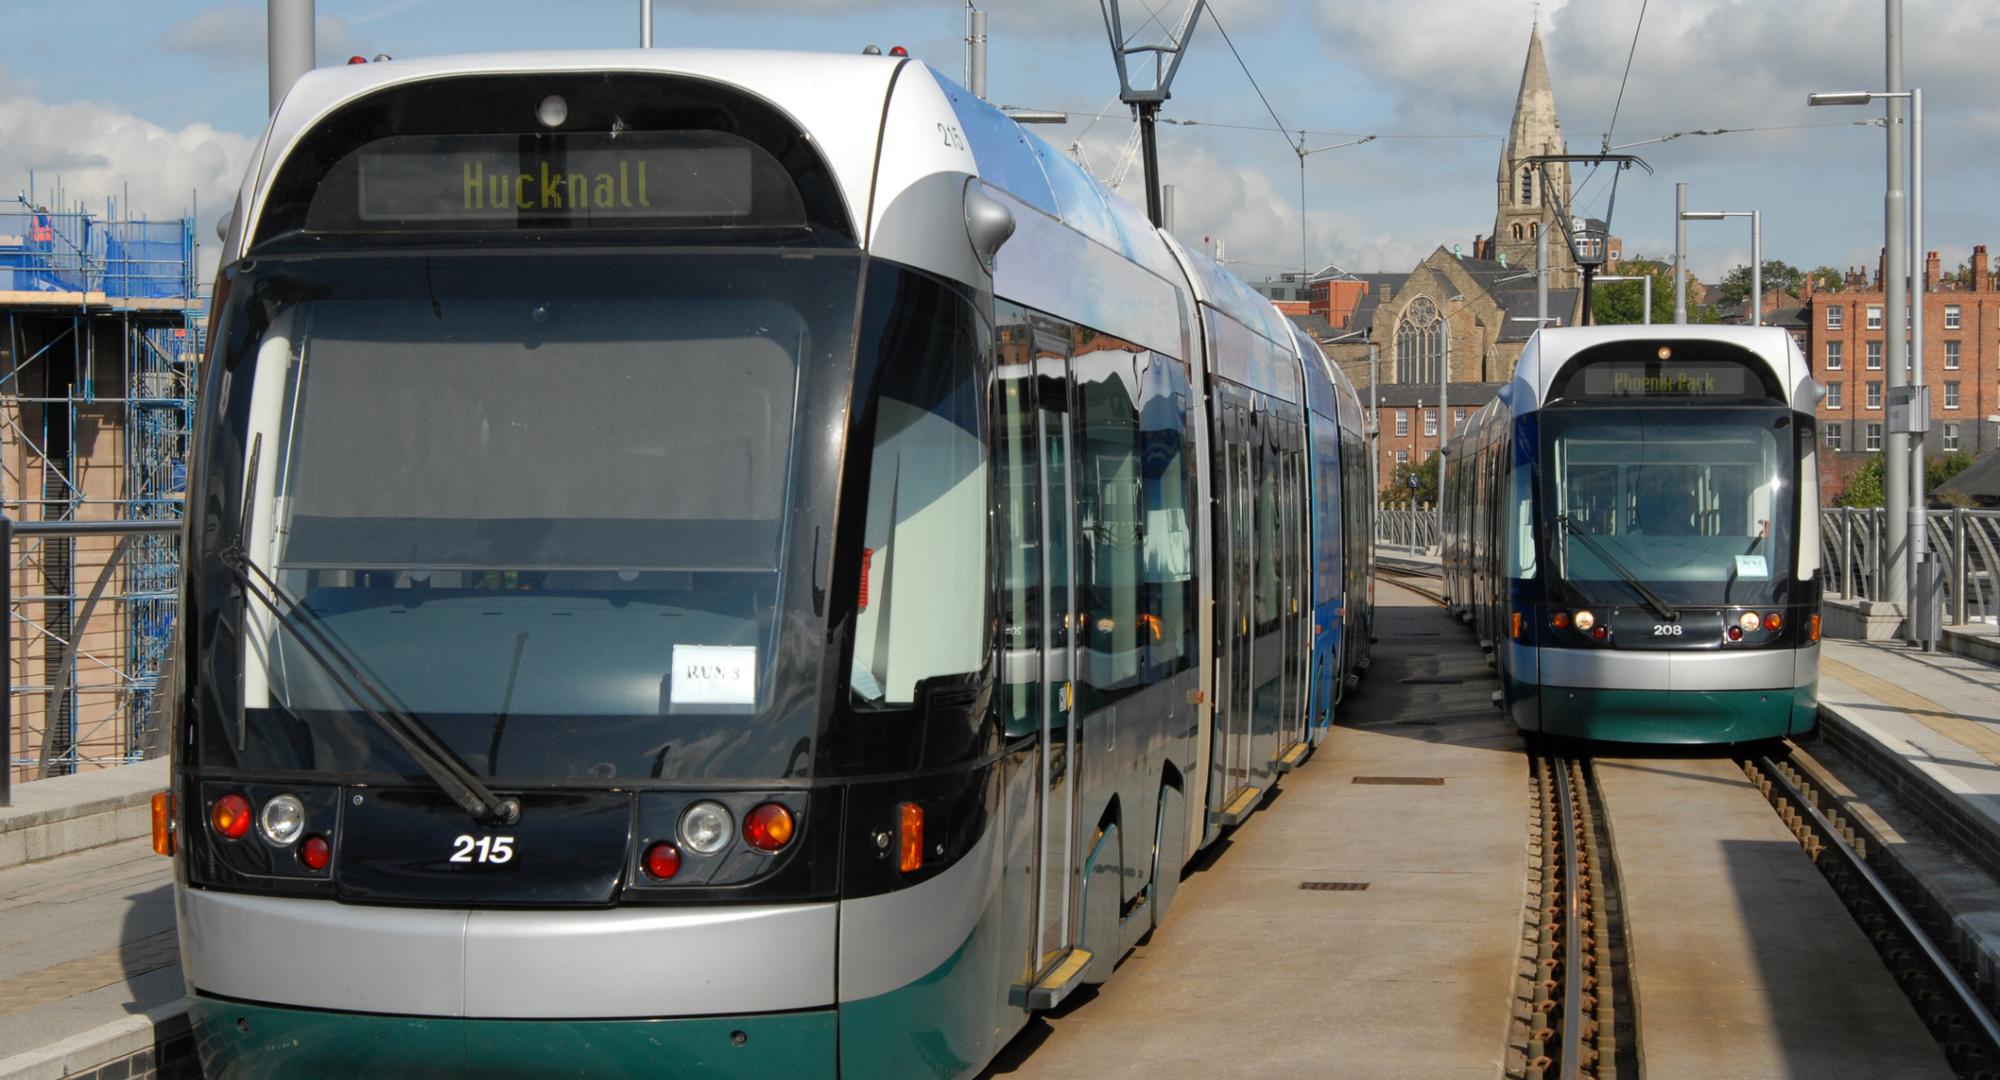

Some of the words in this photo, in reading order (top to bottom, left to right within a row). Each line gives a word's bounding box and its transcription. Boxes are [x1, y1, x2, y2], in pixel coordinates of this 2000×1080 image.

[937, 122, 964, 151] 215
[463, 160, 650, 209] Hucknall
[1614, 371, 1673, 392] Phoenix
[1678, 371, 1714, 392] Park
[1653, 624, 1682, 636] 208
[687, 665, 726, 680] RUN
[449, 834, 515, 864] 215
